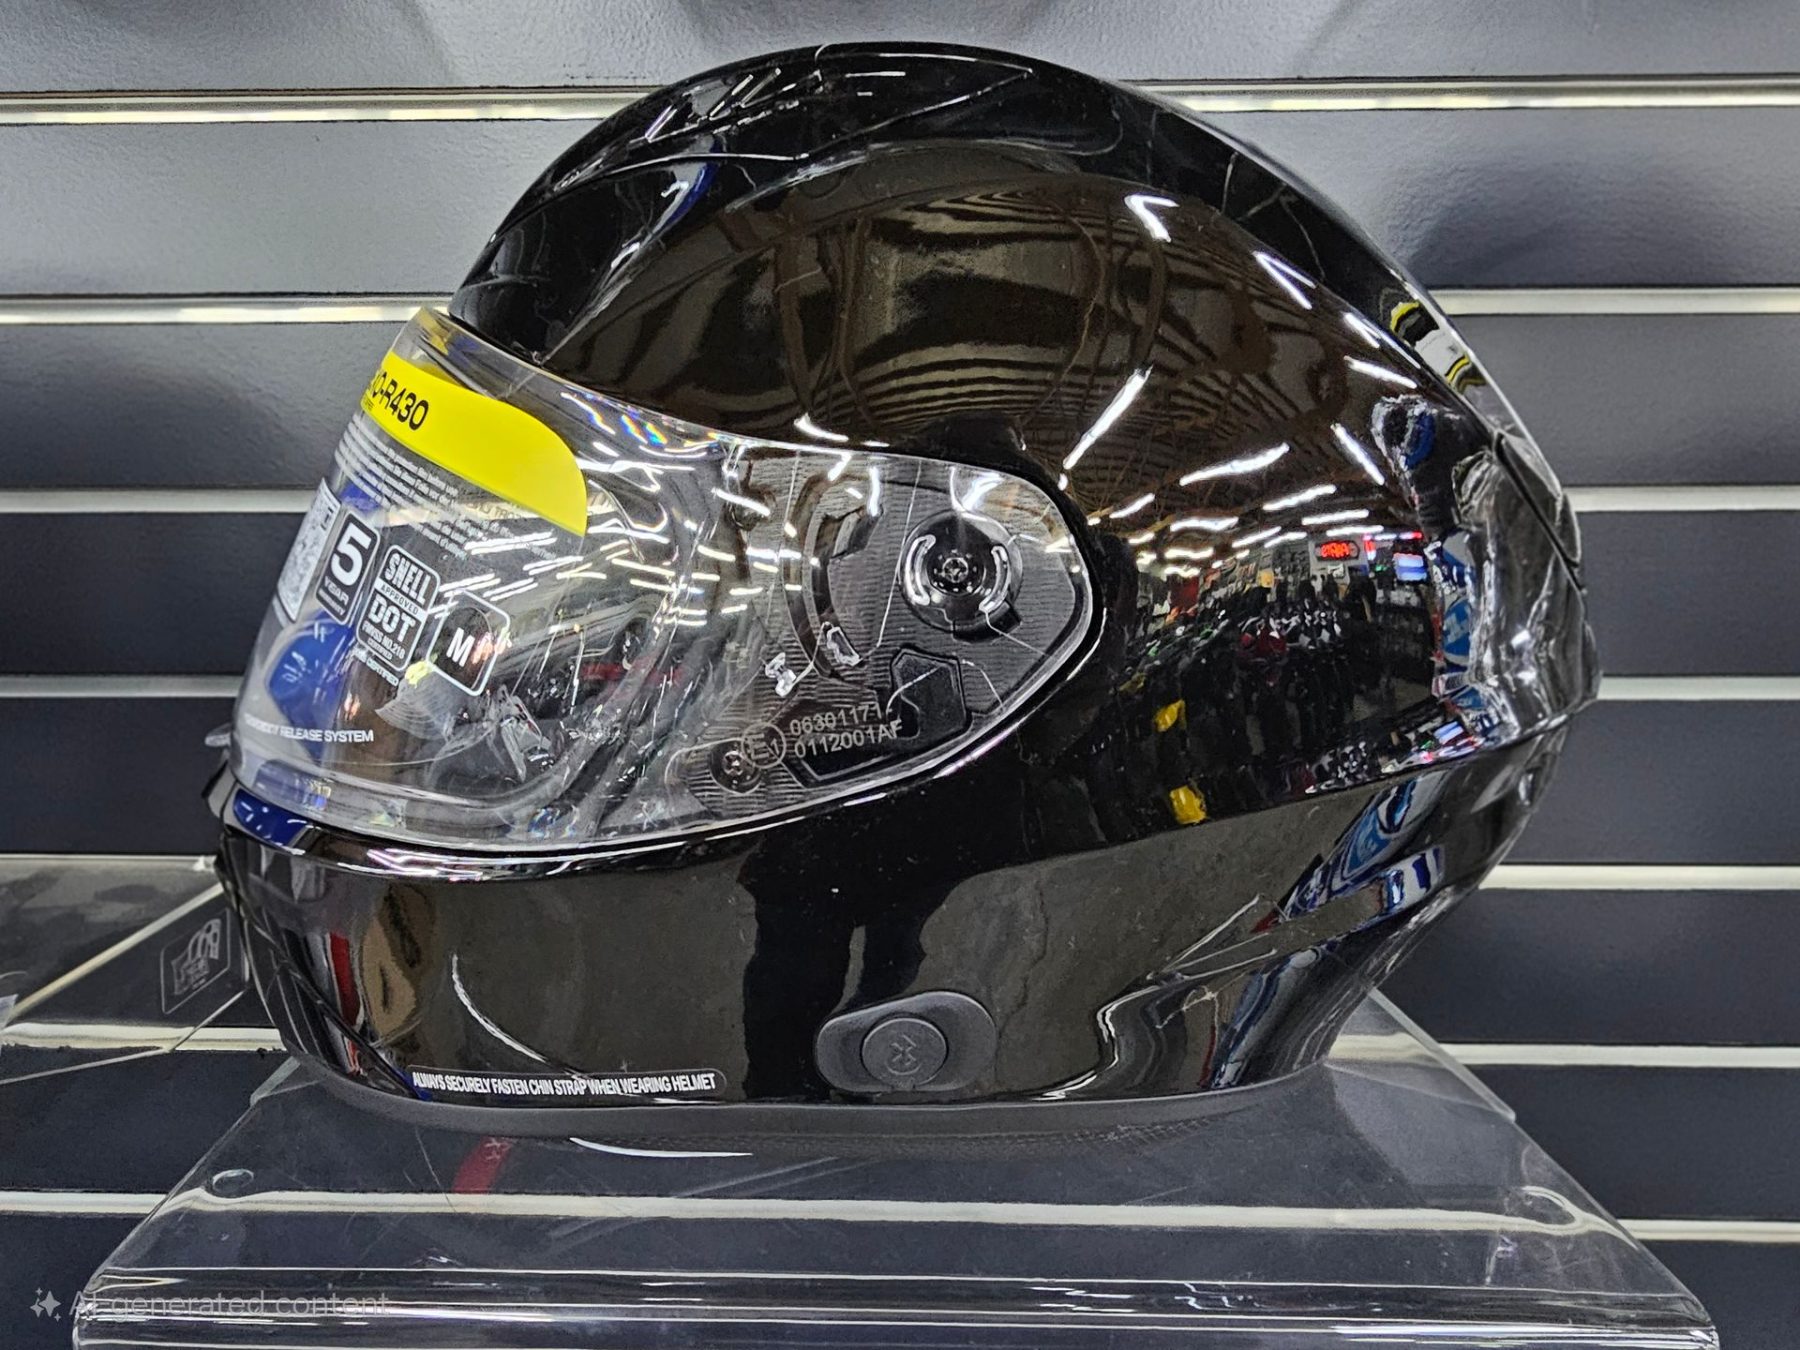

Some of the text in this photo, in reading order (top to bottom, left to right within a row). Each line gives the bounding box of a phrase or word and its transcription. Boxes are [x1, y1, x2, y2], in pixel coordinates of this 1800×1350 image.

[331, 522, 372, 586] 5
[324, 575, 350, 606] YEAR
[384, 553, 431, 605] SNELL
[381, 584, 419, 616] APPROVED
[368, 594, 416, 642] DOT
[446, 627, 475, 667] M
[280, 725, 374, 743] RELEASE SYSTEM
[790, 702, 882, 735] 06301171
[412, 1071, 716, 1095] ALWAYS SECURELY FASTEN CHIN STRAP WHEN WEARING HELMET
